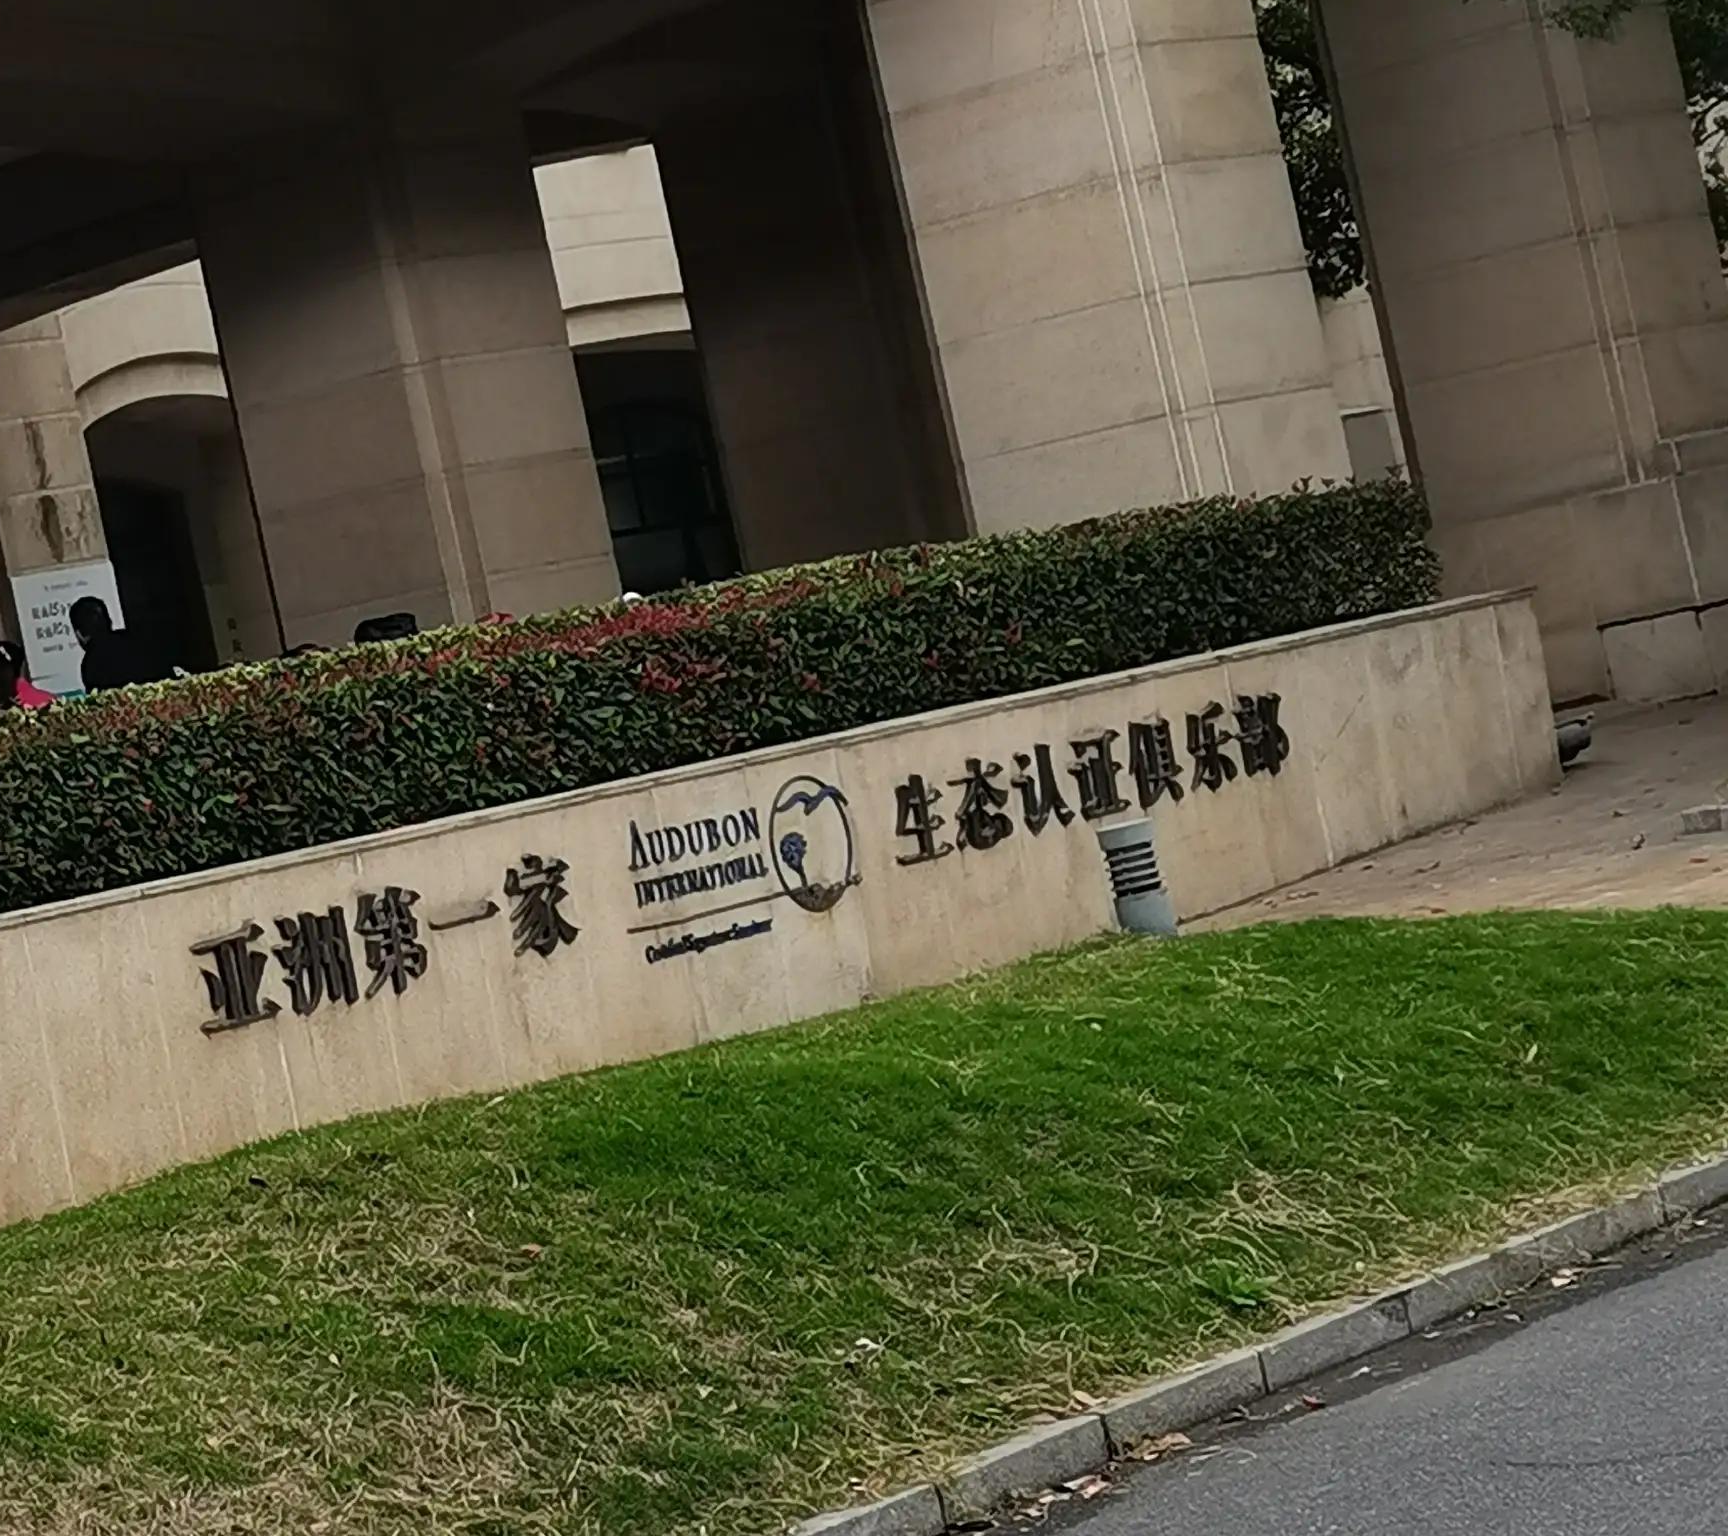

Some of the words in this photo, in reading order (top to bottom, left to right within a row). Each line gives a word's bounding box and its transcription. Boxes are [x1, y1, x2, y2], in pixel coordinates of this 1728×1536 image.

[895, 692, 1290, 866] 生态认证俱乐部
[628, 807, 761, 872] AUDUBON
[634, 852, 769, 908] INTERNATIONAL
[189, 852, 582, 1039] 亚洲第一家
